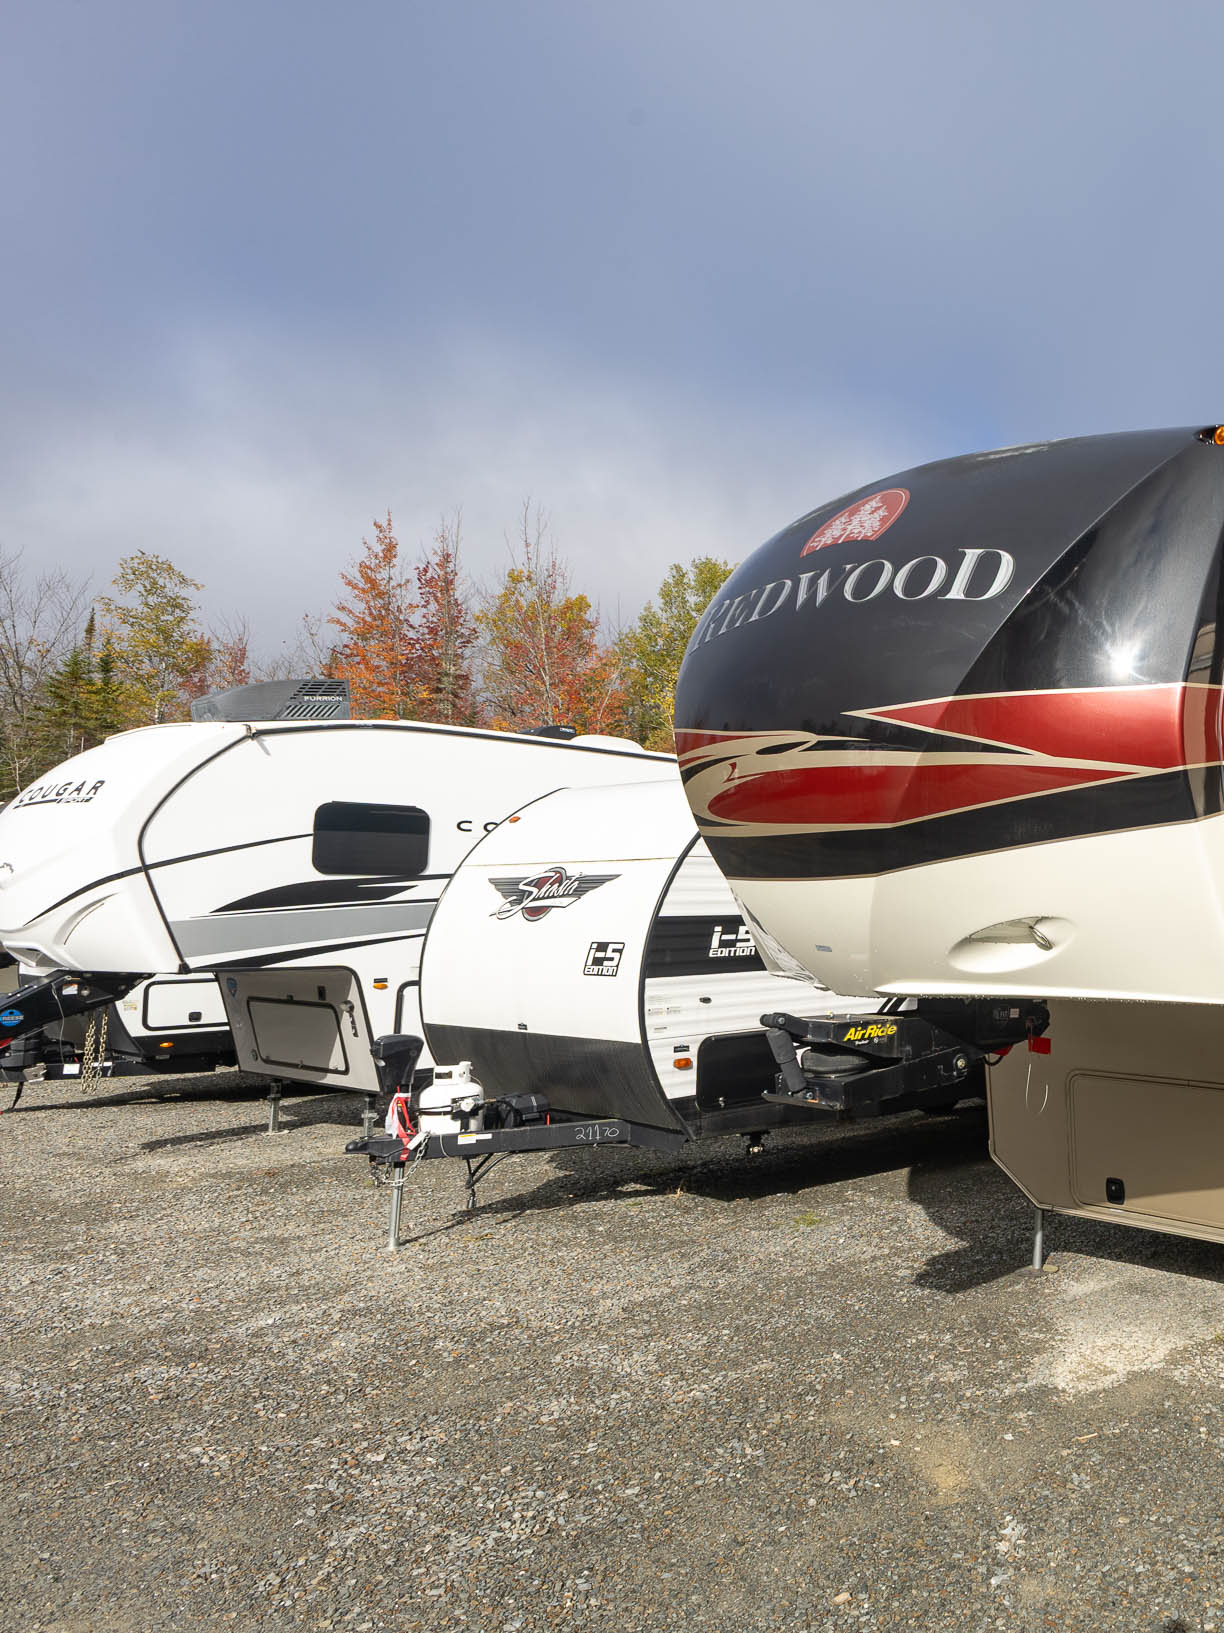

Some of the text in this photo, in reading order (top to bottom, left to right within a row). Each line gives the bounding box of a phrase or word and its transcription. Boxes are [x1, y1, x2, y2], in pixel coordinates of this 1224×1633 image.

[687, 548, 1015, 656] REDWOOD
[18, 780, 105, 804] COUGAR
[489, 871, 582, 920] Shasta
[708, 946, 756, 957] EDITION
[584, 965, 618, 976] EDITION
[574, 1124, 620, 1140] 21170
